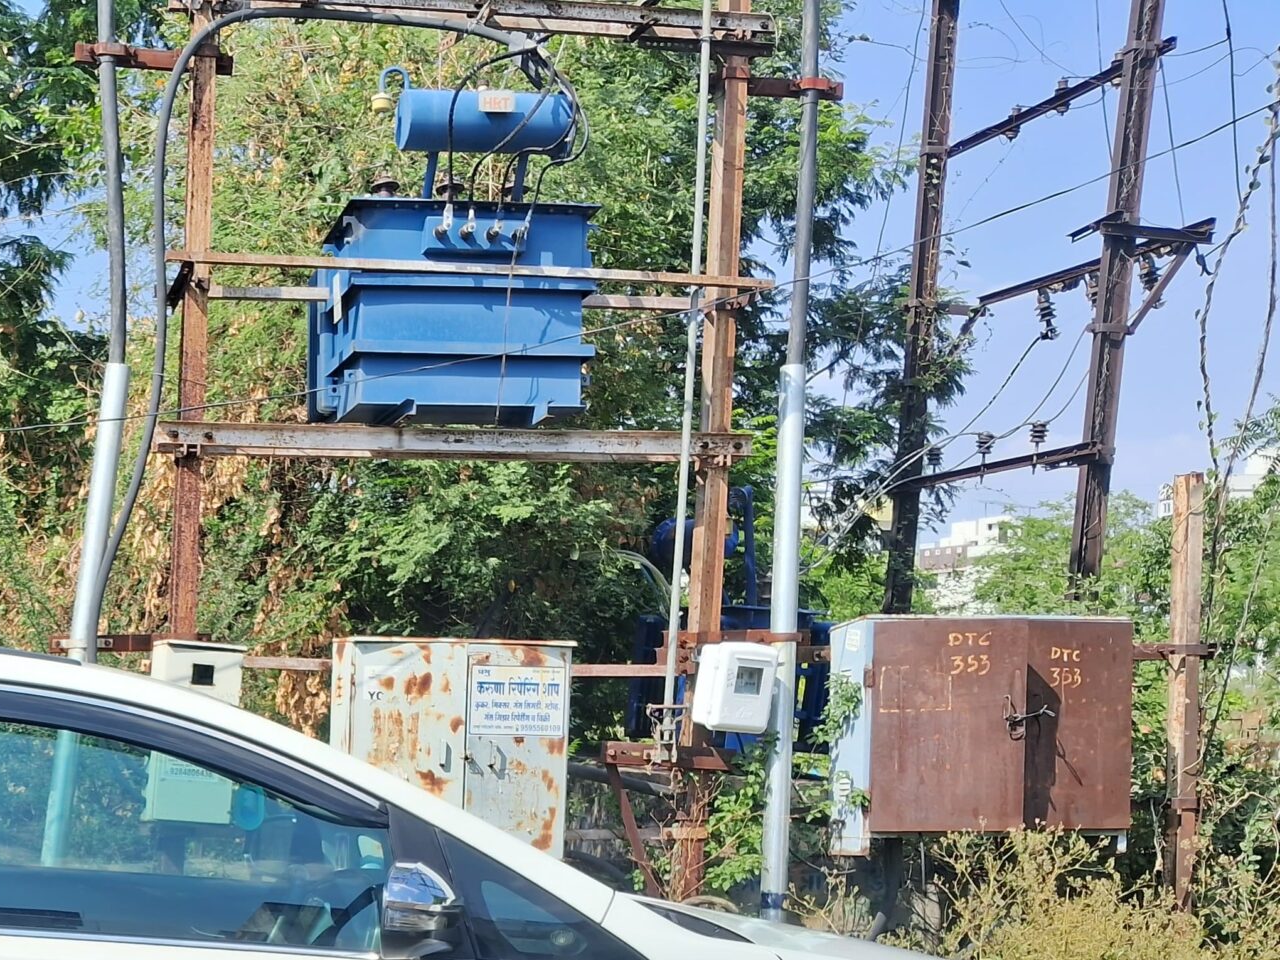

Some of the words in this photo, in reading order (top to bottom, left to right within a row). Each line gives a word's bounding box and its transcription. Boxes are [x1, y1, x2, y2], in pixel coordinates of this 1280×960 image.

[948, 632, 992, 646] DTC
[1050, 647, 1081, 662] DTC
[950, 654, 991, 675] 353
[476, 681, 505, 695] करुणा
